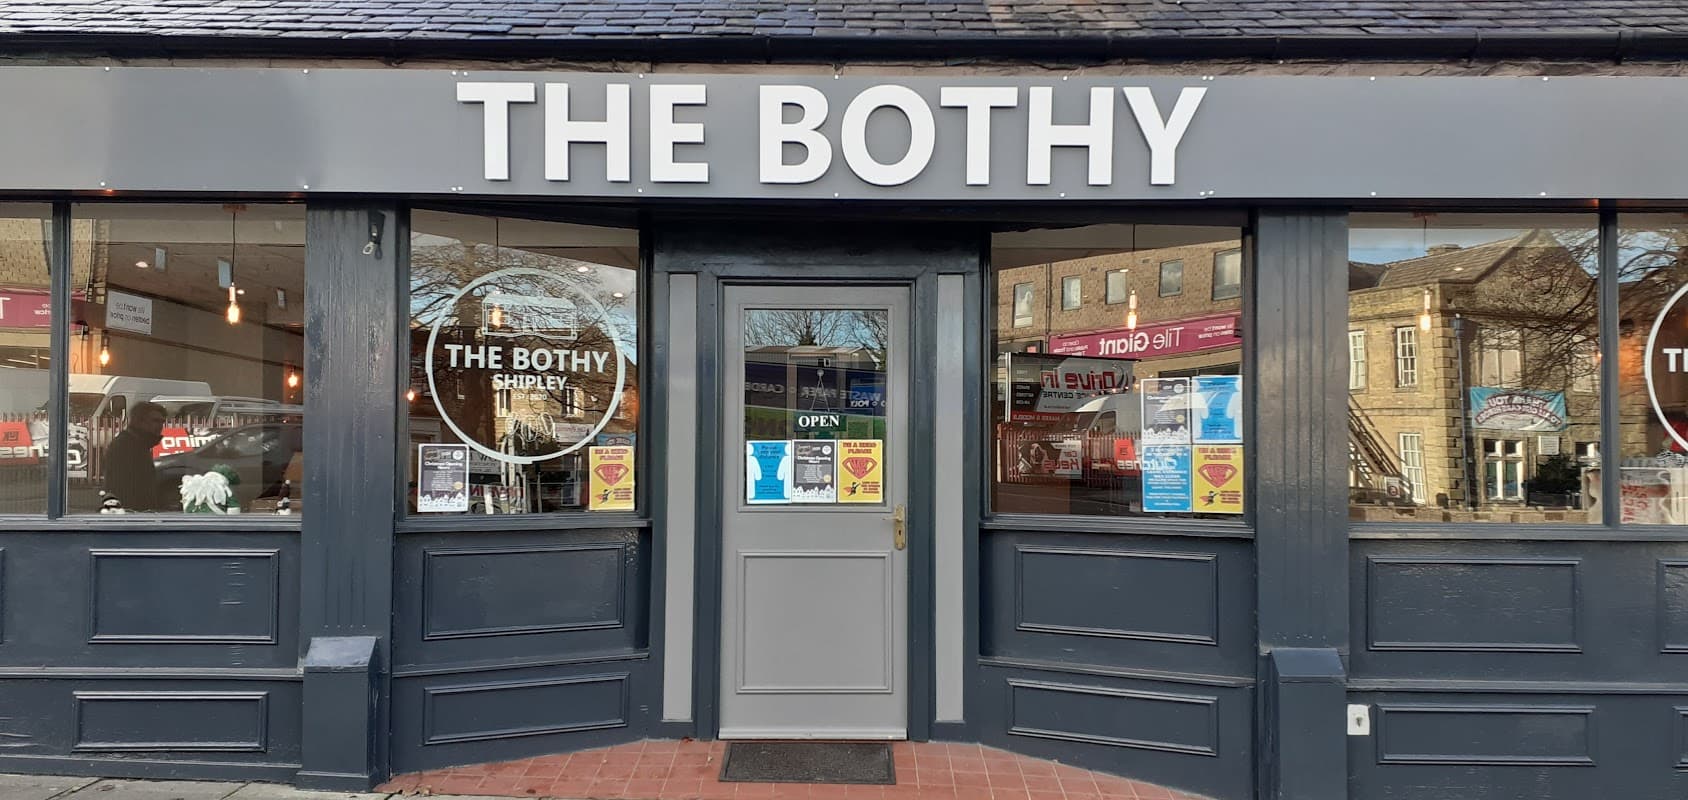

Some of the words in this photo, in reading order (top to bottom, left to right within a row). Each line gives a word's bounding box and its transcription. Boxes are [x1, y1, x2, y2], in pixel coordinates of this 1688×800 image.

[456, 82, 710, 183] THE
[759, 84, 1209, 187] BOTHY
[444, 344, 503, 370] THE
[513, 347, 610, 373] BOTHY
[492, 373, 568, 391] SHIPLEY
[798, 414, 840, 428] OPEN
